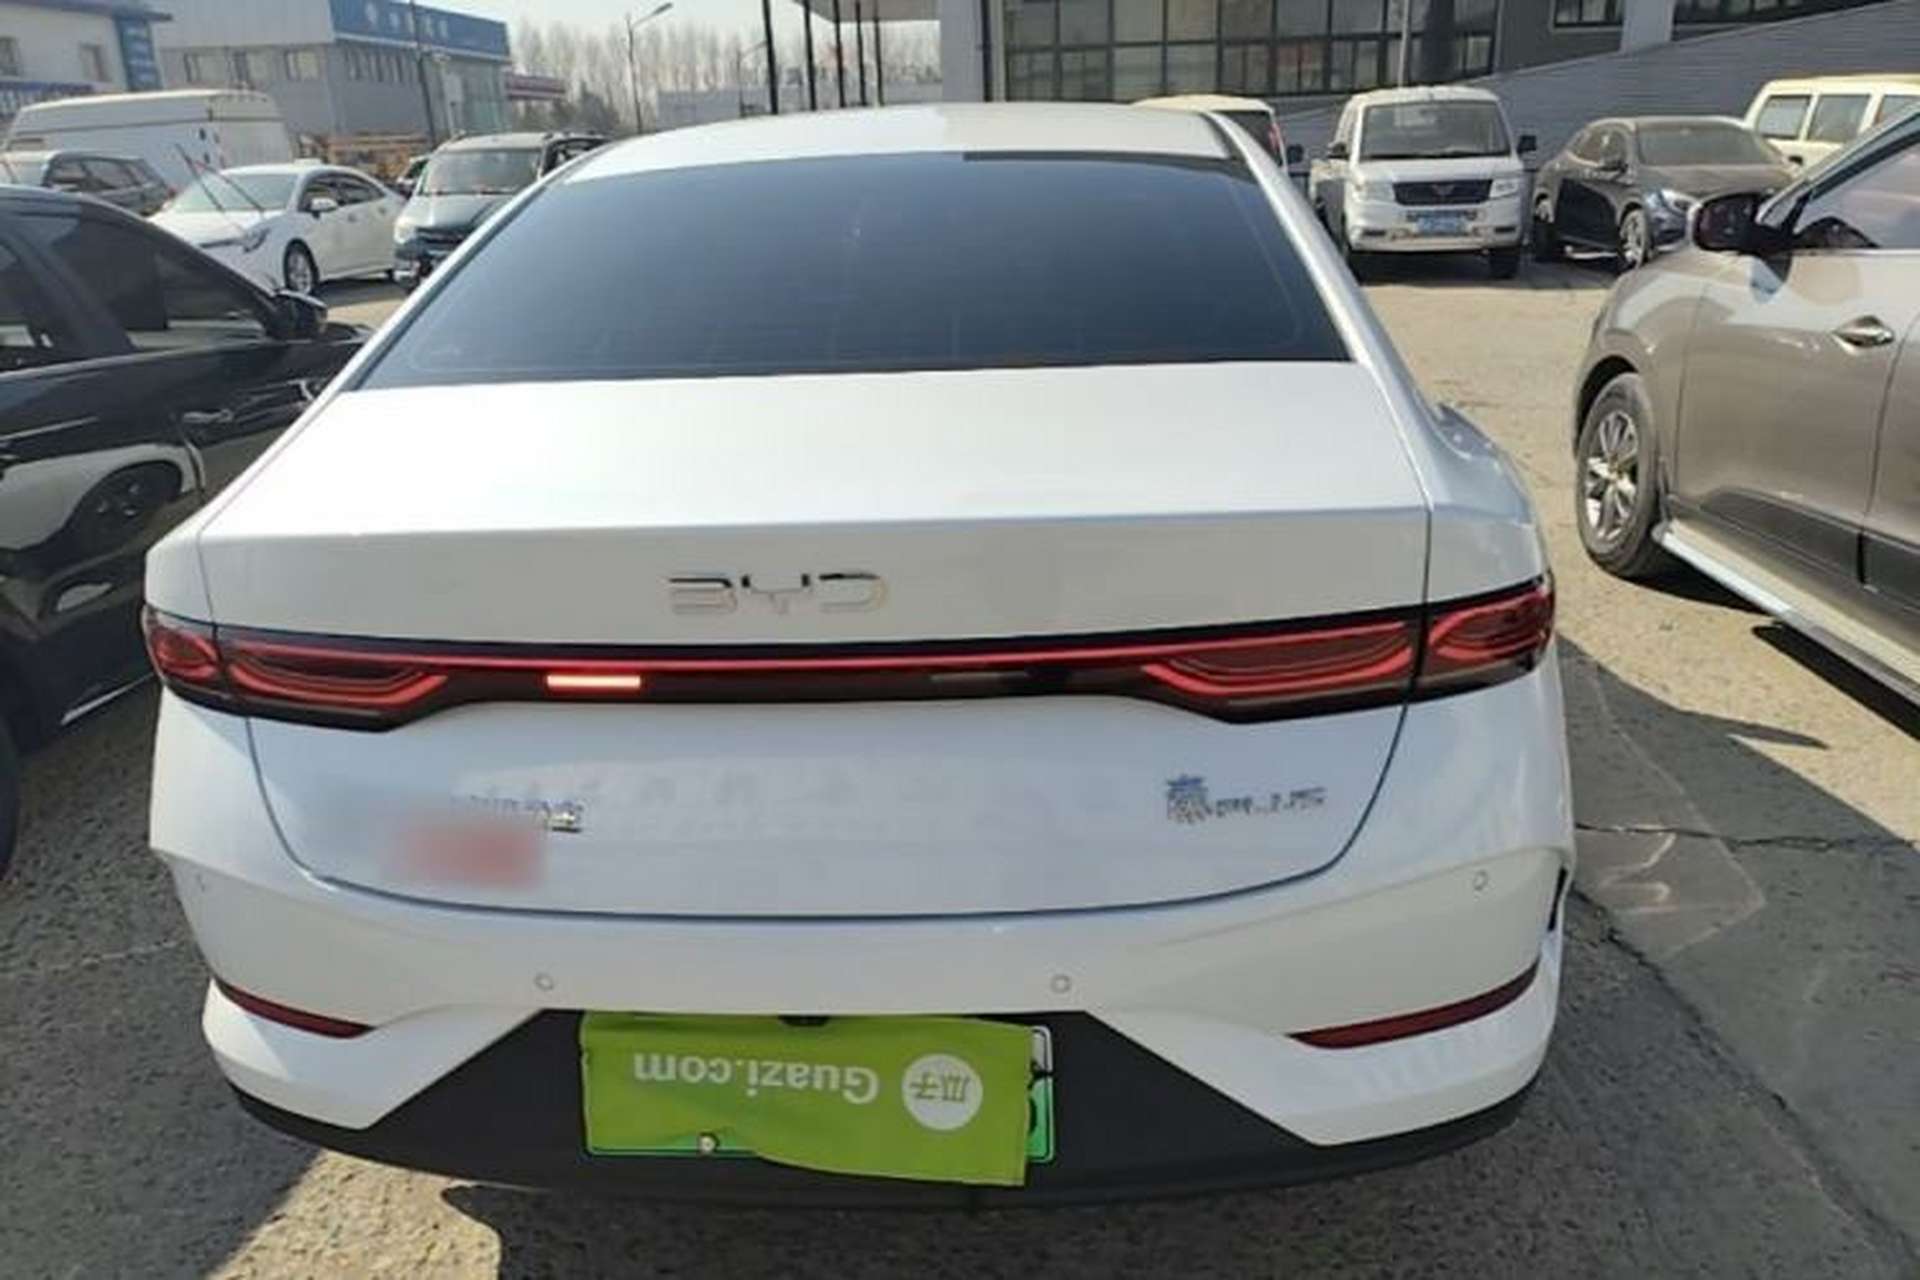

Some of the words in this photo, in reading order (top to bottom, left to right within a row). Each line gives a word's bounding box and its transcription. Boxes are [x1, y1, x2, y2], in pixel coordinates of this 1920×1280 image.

[668, 571, 888, 615] BYD
[633, 1052, 880, 1104] Guazi.com
[910, 1071, 970, 1102] 瓜子
